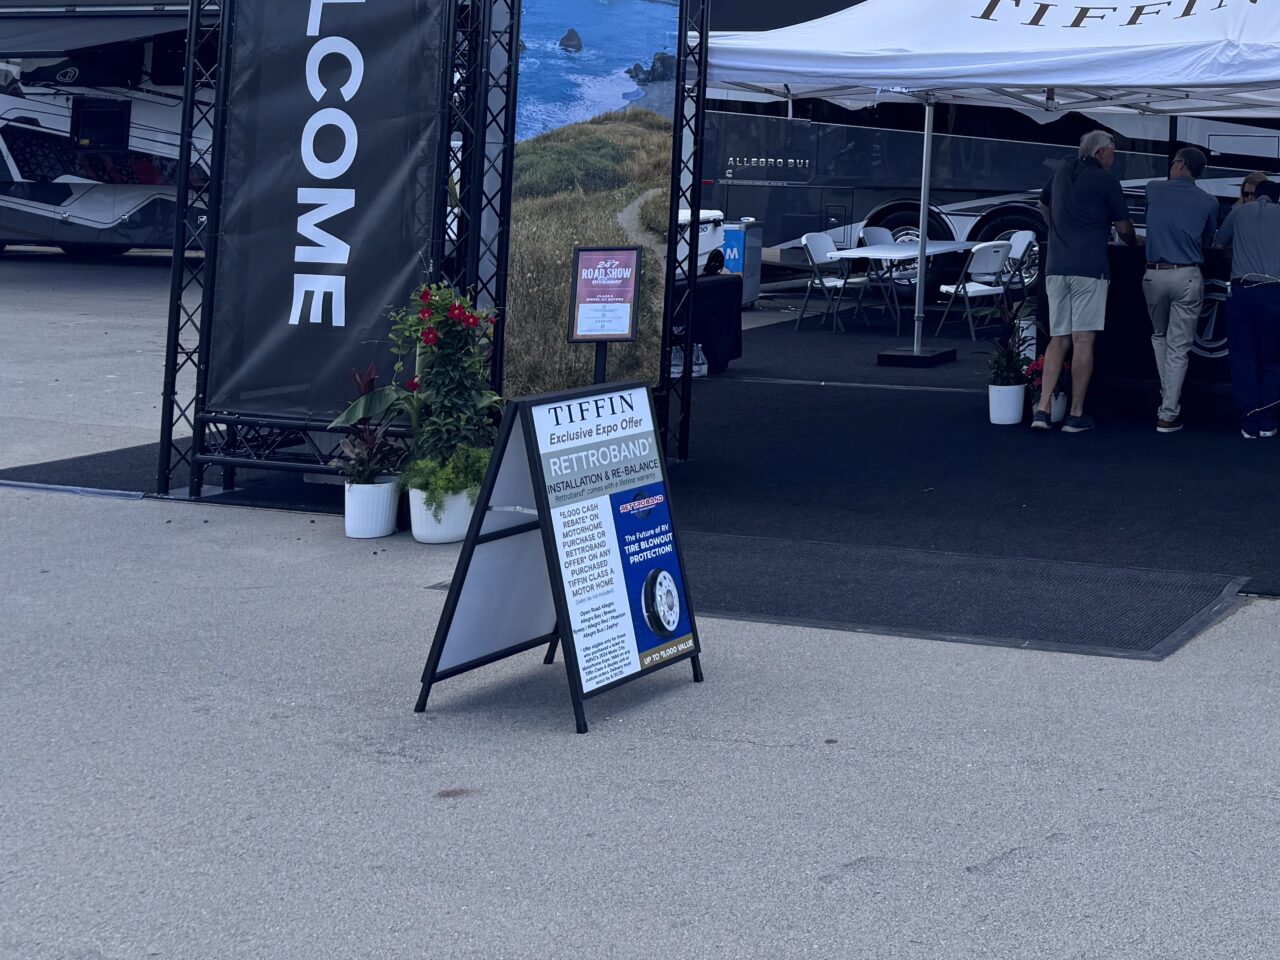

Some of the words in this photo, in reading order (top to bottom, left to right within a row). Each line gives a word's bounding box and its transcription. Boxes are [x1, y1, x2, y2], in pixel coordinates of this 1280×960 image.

[728, 157, 784, 167] ALLEGRO
[582, 268, 605, 280] ROAD
[606, 267, 632, 279] SHOW
[548, 393, 635, 426] TIFFIN
[549, 426, 593, 445] Exclusive
[595, 421, 619, 438] Expo
[620, 415, 643, 430] Offer
[547, 472, 602, 494] INSTALLATION
[604, 471, 609, 480] &
[611, 459, 659, 478] RE-BALANCE
[587, 485, 603, 494] comes
[582, 503, 598, 513] CASH
[590, 513, 599, 521] ON
[562, 521, 603, 538] MOTORHOME
[625, 533, 635, 542] The
[636, 528, 654, 539] Future
[661, 523, 669, 531] RV
[562, 533, 595, 548] PURCHASE
[597, 530, 605, 538] OR
[624, 543, 639, 554] TIRE
[640, 532, 673, 549] BLOWOUT
[566, 540, 606, 558] RETTROBAND
[588, 553, 597, 561] ON
[599, 548, 611, 558] ANY
[629, 544, 673, 565] PROTECTION!
[571, 559, 608, 577] PURCHASED
[568, 576, 587, 588] TIFFIN
[589, 569, 608, 581] CLASS
[572, 584, 595, 597] MOTOR
[596, 577, 614, 589] HOME
[644, 656, 651, 664] UP
[652, 653, 659, 661] TO
[678, 639, 693, 650] VALUE
